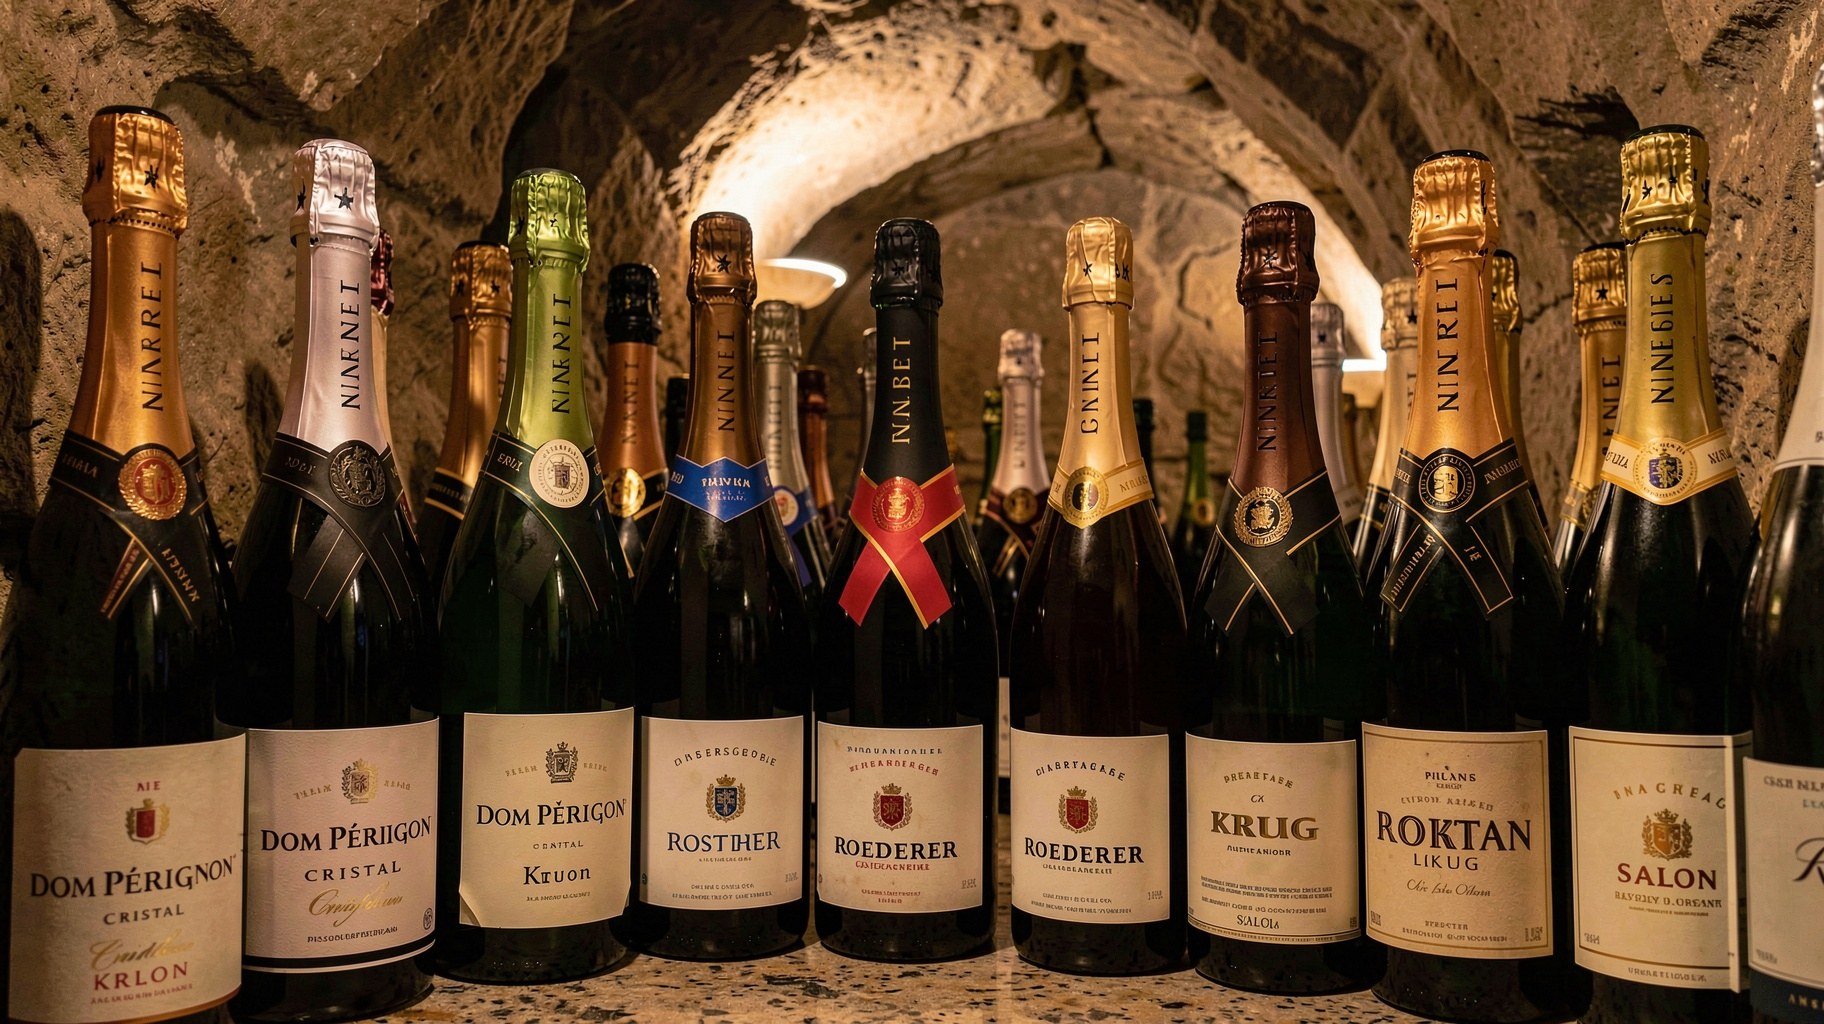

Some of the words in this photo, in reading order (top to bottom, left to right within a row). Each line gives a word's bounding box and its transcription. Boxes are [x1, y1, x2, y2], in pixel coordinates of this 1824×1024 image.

[477, 804, 531, 826] DOM
[1211, 811, 1320, 841] KRUG
[261, 829, 323, 852] DOM
[1377, 810, 1531, 851] ROKTAN
[834, 836, 958, 860] ROEDERER
[1024, 837, 1144, 864] ROEDERER
[305, 860, 402, 882] CRISTAL
[1414, 853, 1479, 871] LIKUG
[31, 873, 96, 898] DOM
[103, 855, 233, 896] PÉRIGNON
[1617, 862, 1718, 890] SALON
[103, 904, 185, 925] CRISTAL
[94, 961, 188, 991] KRLON
